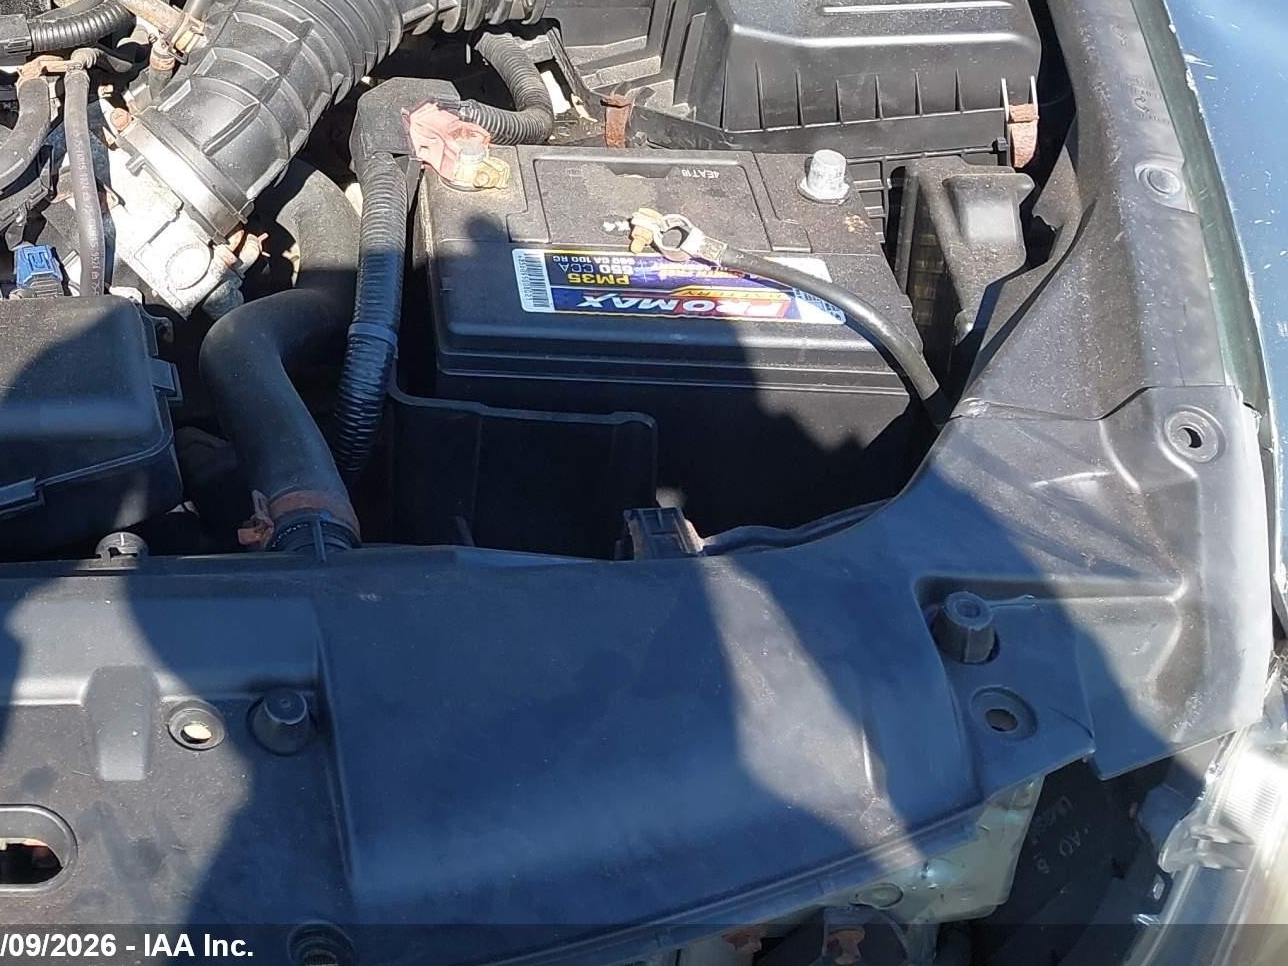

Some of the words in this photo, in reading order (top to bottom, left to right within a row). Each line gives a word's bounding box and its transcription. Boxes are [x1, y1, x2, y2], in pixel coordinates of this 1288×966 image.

[553, 255, 569, 263] RC
[558, 263, 595, 274] CCA
[567, 274, 630, 286] PM35
